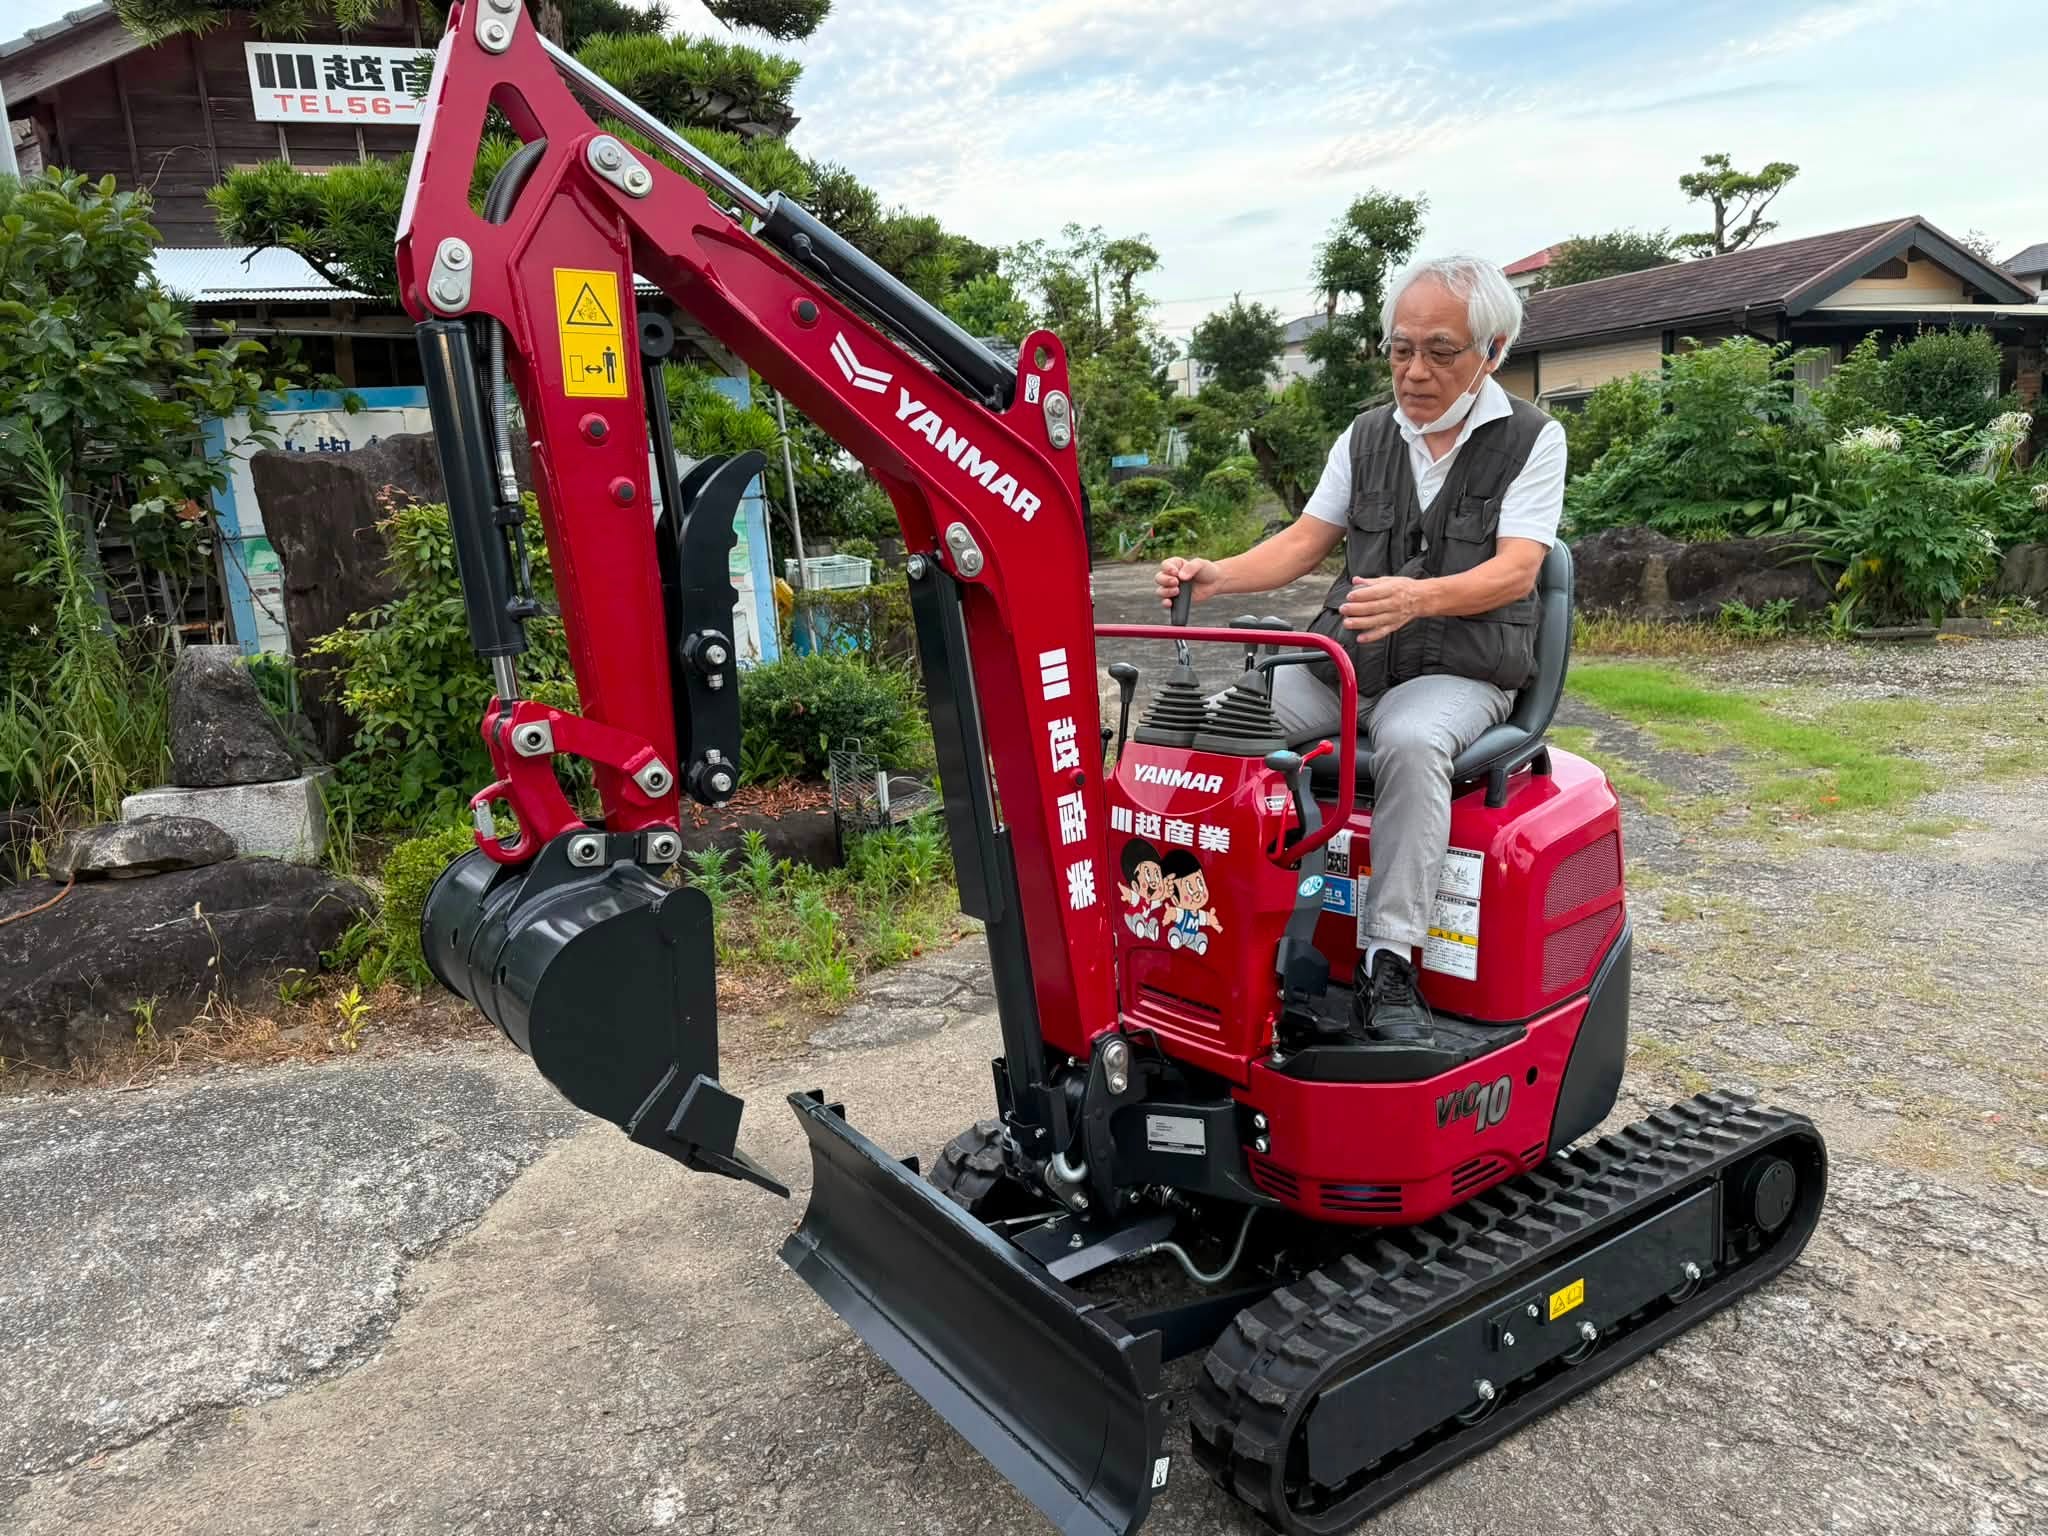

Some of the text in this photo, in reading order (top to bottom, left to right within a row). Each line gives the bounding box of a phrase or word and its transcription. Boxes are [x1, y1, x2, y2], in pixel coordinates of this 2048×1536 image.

[895, 387, 1042, 522] YANMAR
[1039, 648, 1096, 911] 川越産業
[1134, 764, 1224, 794] YANMAR
[1111, 805, 1231, 854] 川越産業
[1186, 917, 1199, 931] M
